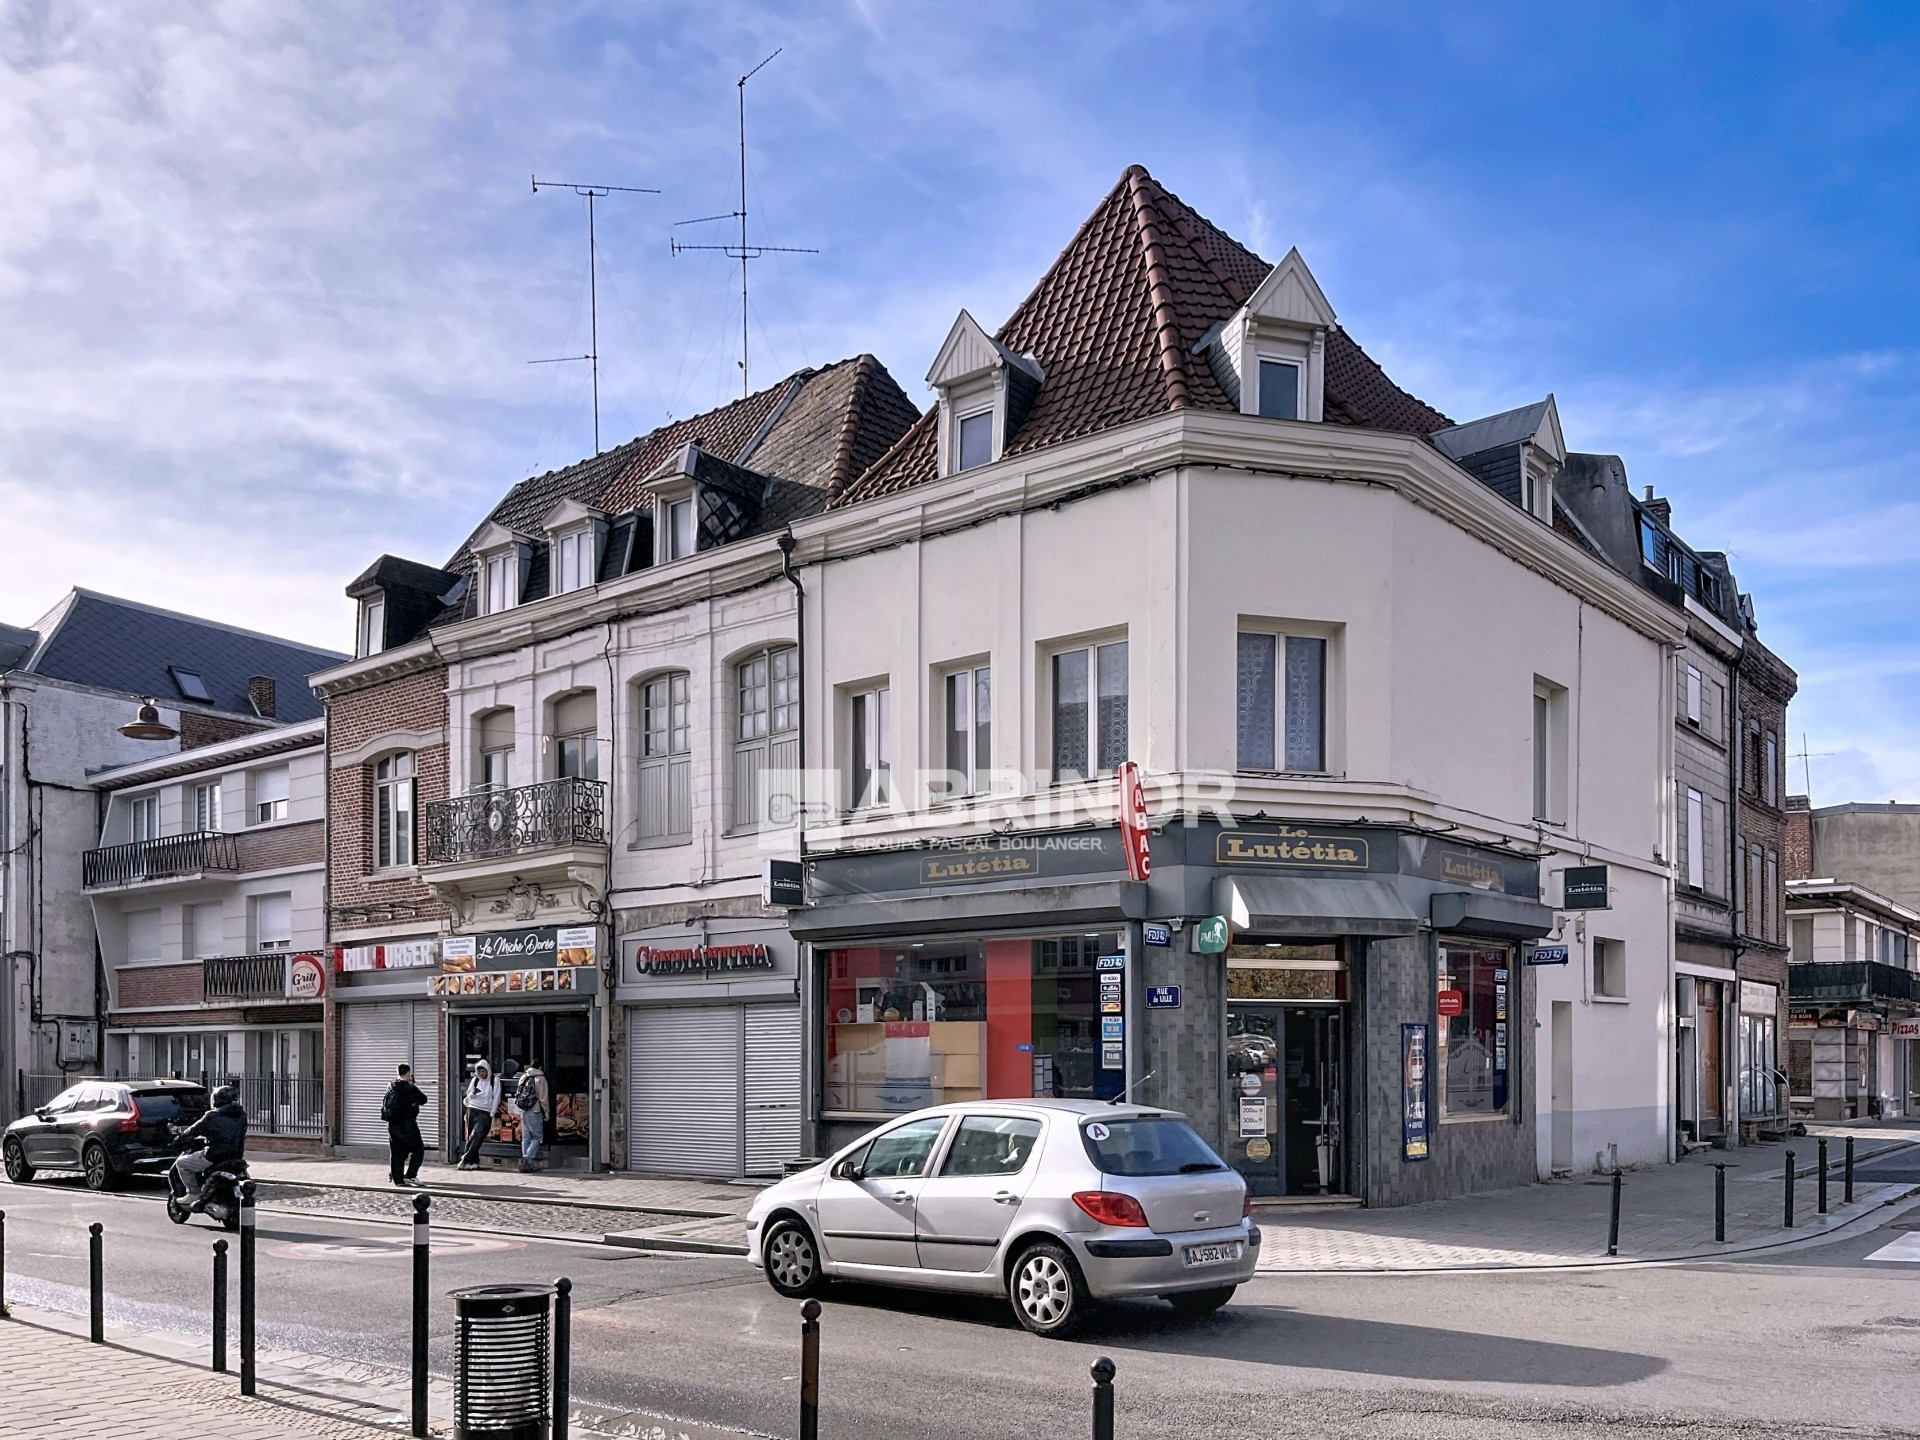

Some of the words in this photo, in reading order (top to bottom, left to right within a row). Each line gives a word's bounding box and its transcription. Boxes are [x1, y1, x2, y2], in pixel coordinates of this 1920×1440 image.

[1131, 766, 1150, 875] TABAC
[1279, 826, 1308, 838] Le
[1227, 839, 1358, 862] Lutétia
[927, 855, 1030, 878] Lutétia
[1444, 857, 1500, 882] Lutétia
[1148, 930, 1160, 940] FDJ
[477, 937, 495, 959] La
[493, 936, 524, 955] Miche
[523, 933, 556, 956] Dorée
[334, 947, 373, 972] GRILL
[375, 941, 435, 969] BURGER
[1535, 951, 1551, 960] FDJ
[1098, 958, 1114, 968] FDJ
[292, 972, 317, 986] Grill
[1156, 987, 1168, 995] RUE
[1160, 994, 1173, 1003] LILLE
[1891, 1022, 1919, 1035] Pizzas
[1093, 1125, 1106, 1138] A
